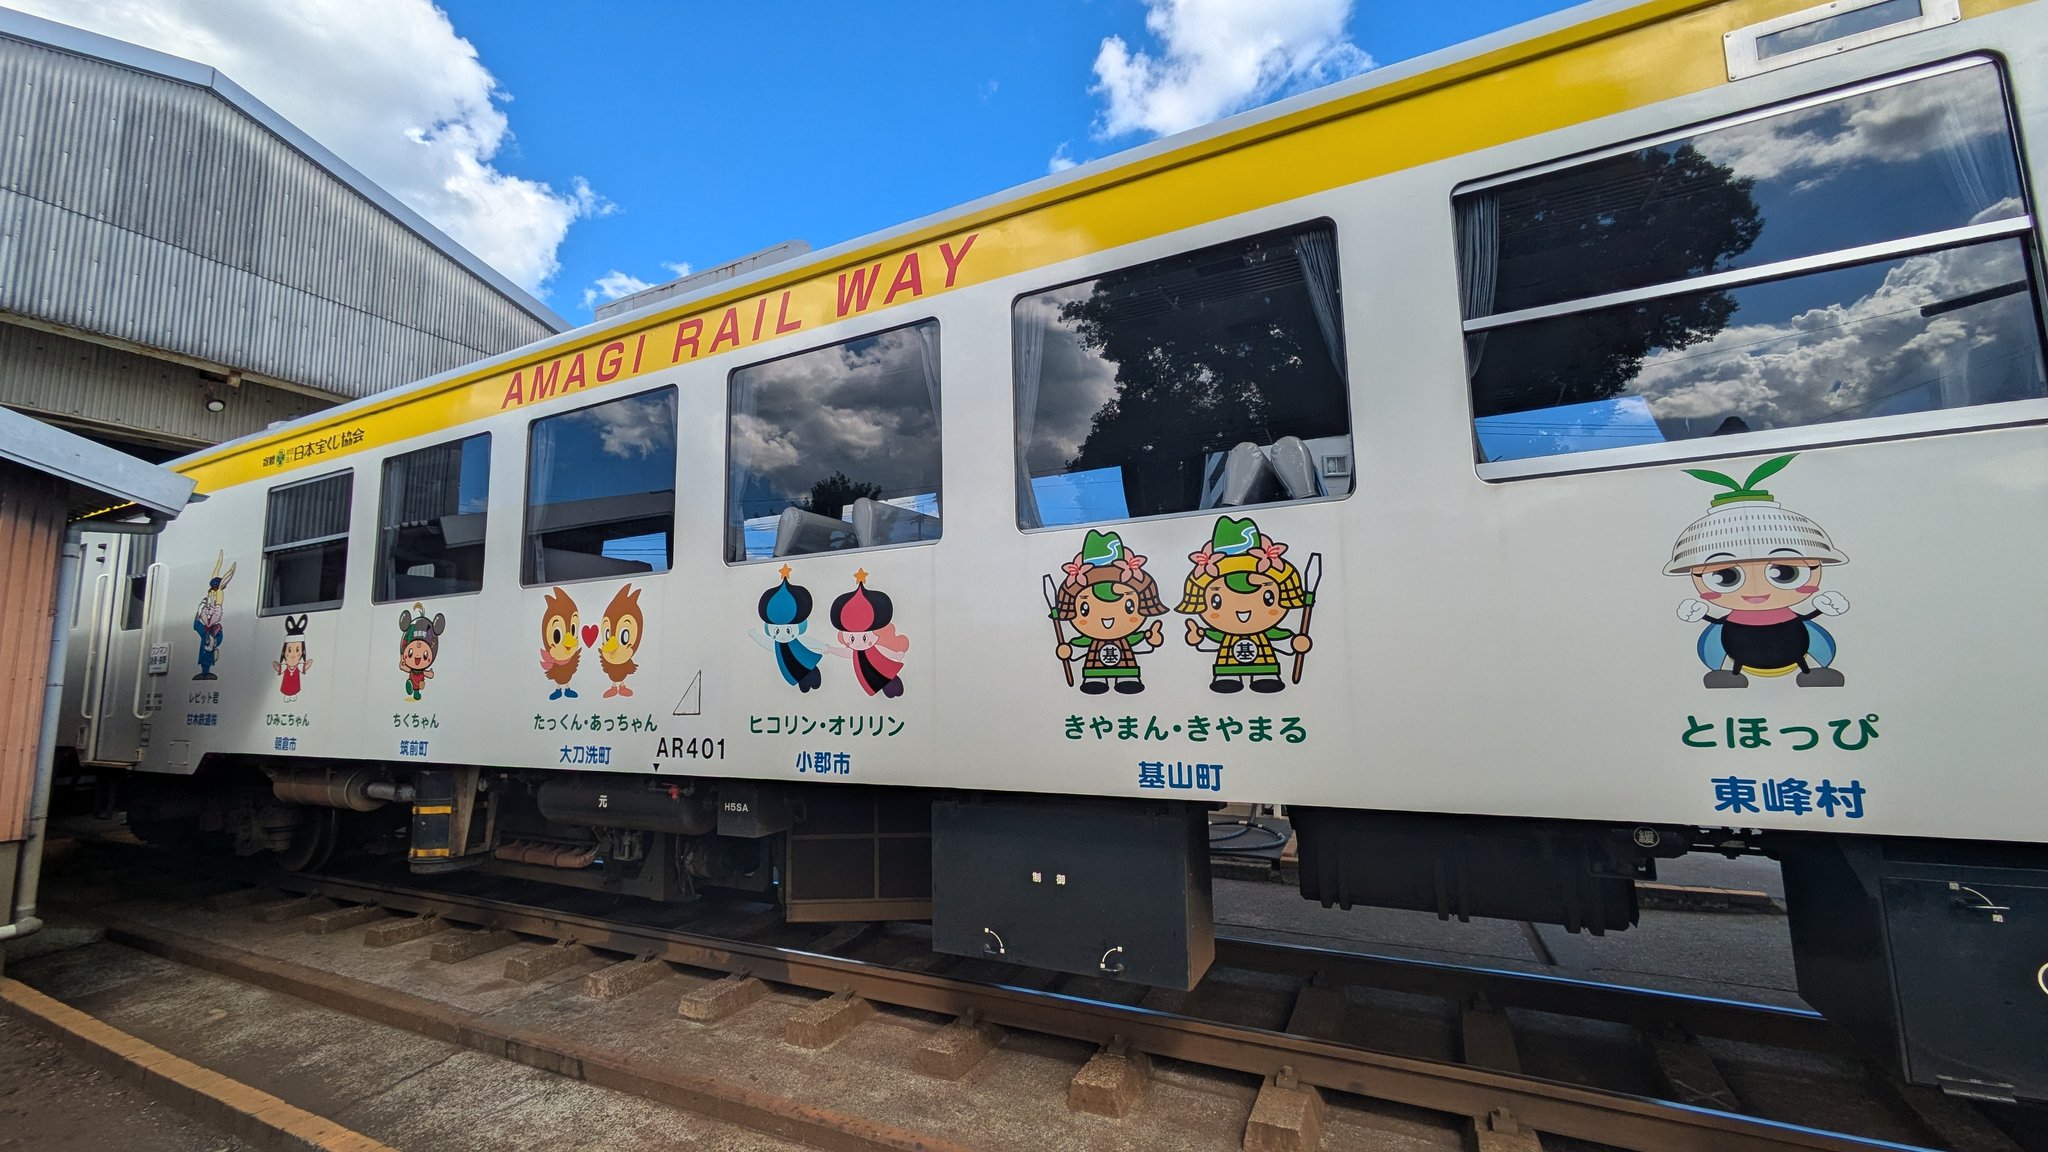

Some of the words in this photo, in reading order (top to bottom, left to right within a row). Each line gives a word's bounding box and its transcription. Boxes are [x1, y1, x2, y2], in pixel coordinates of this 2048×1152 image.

[500, 333, 646, 410] AMAGI
[672, 290, 802, 364] RAIL
[836, 233, 980, 317] WAY
[294, 428, 365, 461] 日本宝くじ協会
[1102, 647, 1119, 663] 基
[1237, 643, 1255, 660] 基
[266, 713, 310, 728] ひみこちゃん
[393, 713, 439, 729] ちくちゃん
[534, 713, 658, 733] たっくん・あっちゃん
[750, 715, 905, 737] ヒコリン・オリリン
[1064, 715, 1307, 744] きやまん・きやまる
[1681, 713, 1880, 751] とほっぴ
[274, 737, 297, 751] 朝倉市
[399, 740, 428, 757] 筑前町
[559, 744, 611, 765] 大刀洗町
[656, 737, 726, 760] AR401
[796, 751, 850, 775] 小郡市
[1138, 761, 1223, 791] 基山町
[598, 795, 608, 807] 元
[724, 802, 749, 813] H5SA
[1711, 776, 1866, 819] 東峰村
